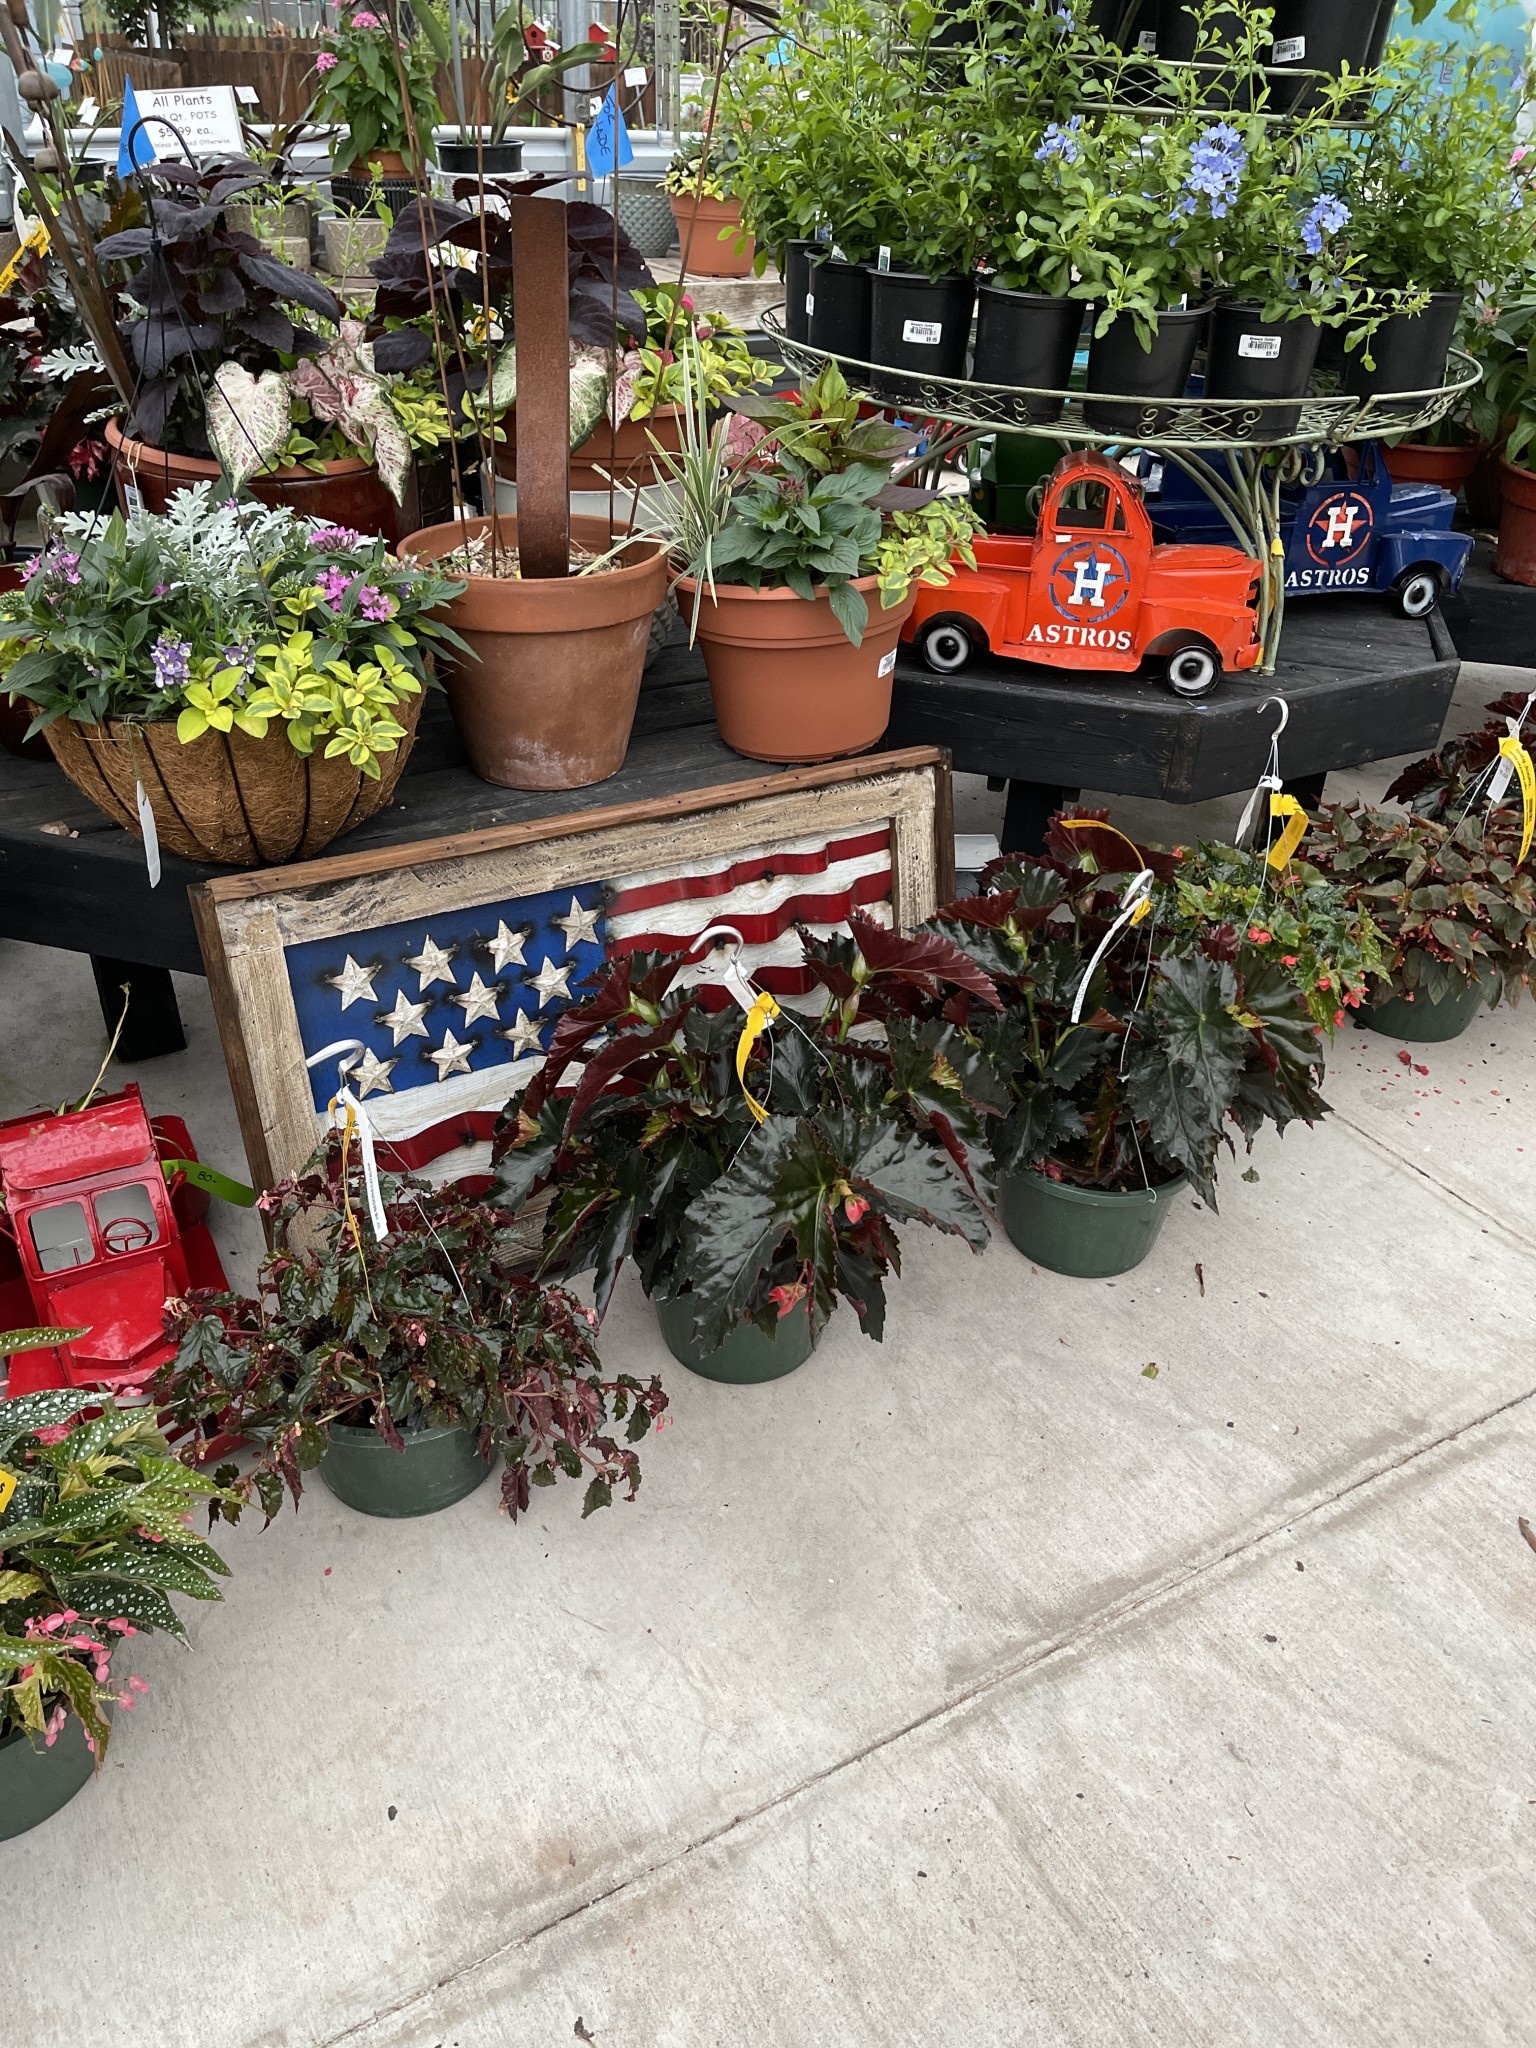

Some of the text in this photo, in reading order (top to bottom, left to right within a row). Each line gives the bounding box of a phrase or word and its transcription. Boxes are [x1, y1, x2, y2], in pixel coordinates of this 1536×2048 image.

[663, 3, 670, 13] 5
[664, 34, 670, 43] 4
[663, 63, 671, 73] 3
[152, 94, 213, 107] All Plants
[169, 112, 187, 122] Qt.
[190, 110, 217, 120] POTS
[158, 126, 192, 139] $599
[1321, 506, 1359, 548] H
[1067, 560, 1112, 607] H
[1284, 567, 1370, 587] ASTROS
[1026, 623, 1132, 650] ASTROS
